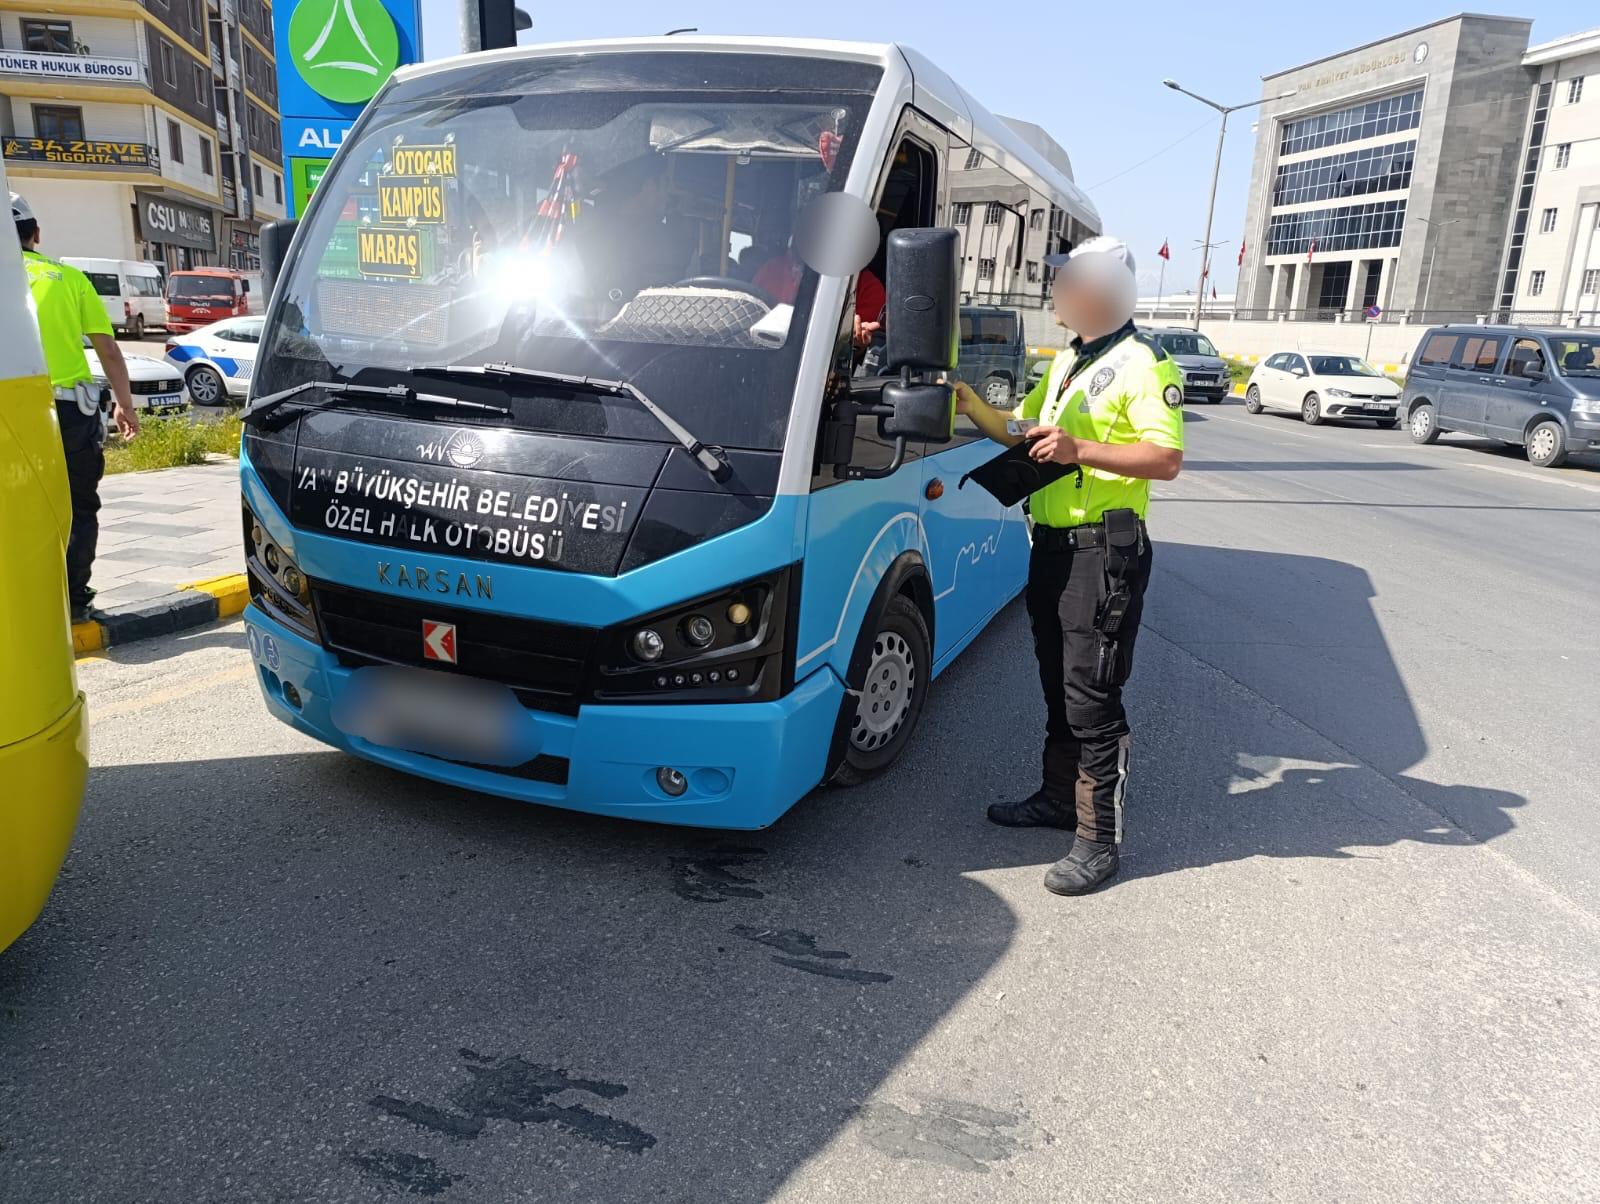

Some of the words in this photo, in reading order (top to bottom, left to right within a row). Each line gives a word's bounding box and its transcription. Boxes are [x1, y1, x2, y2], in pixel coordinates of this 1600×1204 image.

[41, 61, 81, 73] HUKUK
[84, 61, 132, 76] BÜROSU
[30, 139, 63, 151] 3A
[381, 179, 441, 218] KAMPÜS
[148, 202, 176, 233] CSU
[178, 210, 211, 234] MOTORS
[360, 233, 417, 275] MARAŞ
[334, 462, 470, 513] BÜYÜKŞEHİR
[476, 488, 627, 533] BELEDİYESİ
[325, 498, 374, 534] ÖZEL
[445, 520, 564, 562] OTOBÜSÜ
[376, 561, 493, 599] KARSAN
